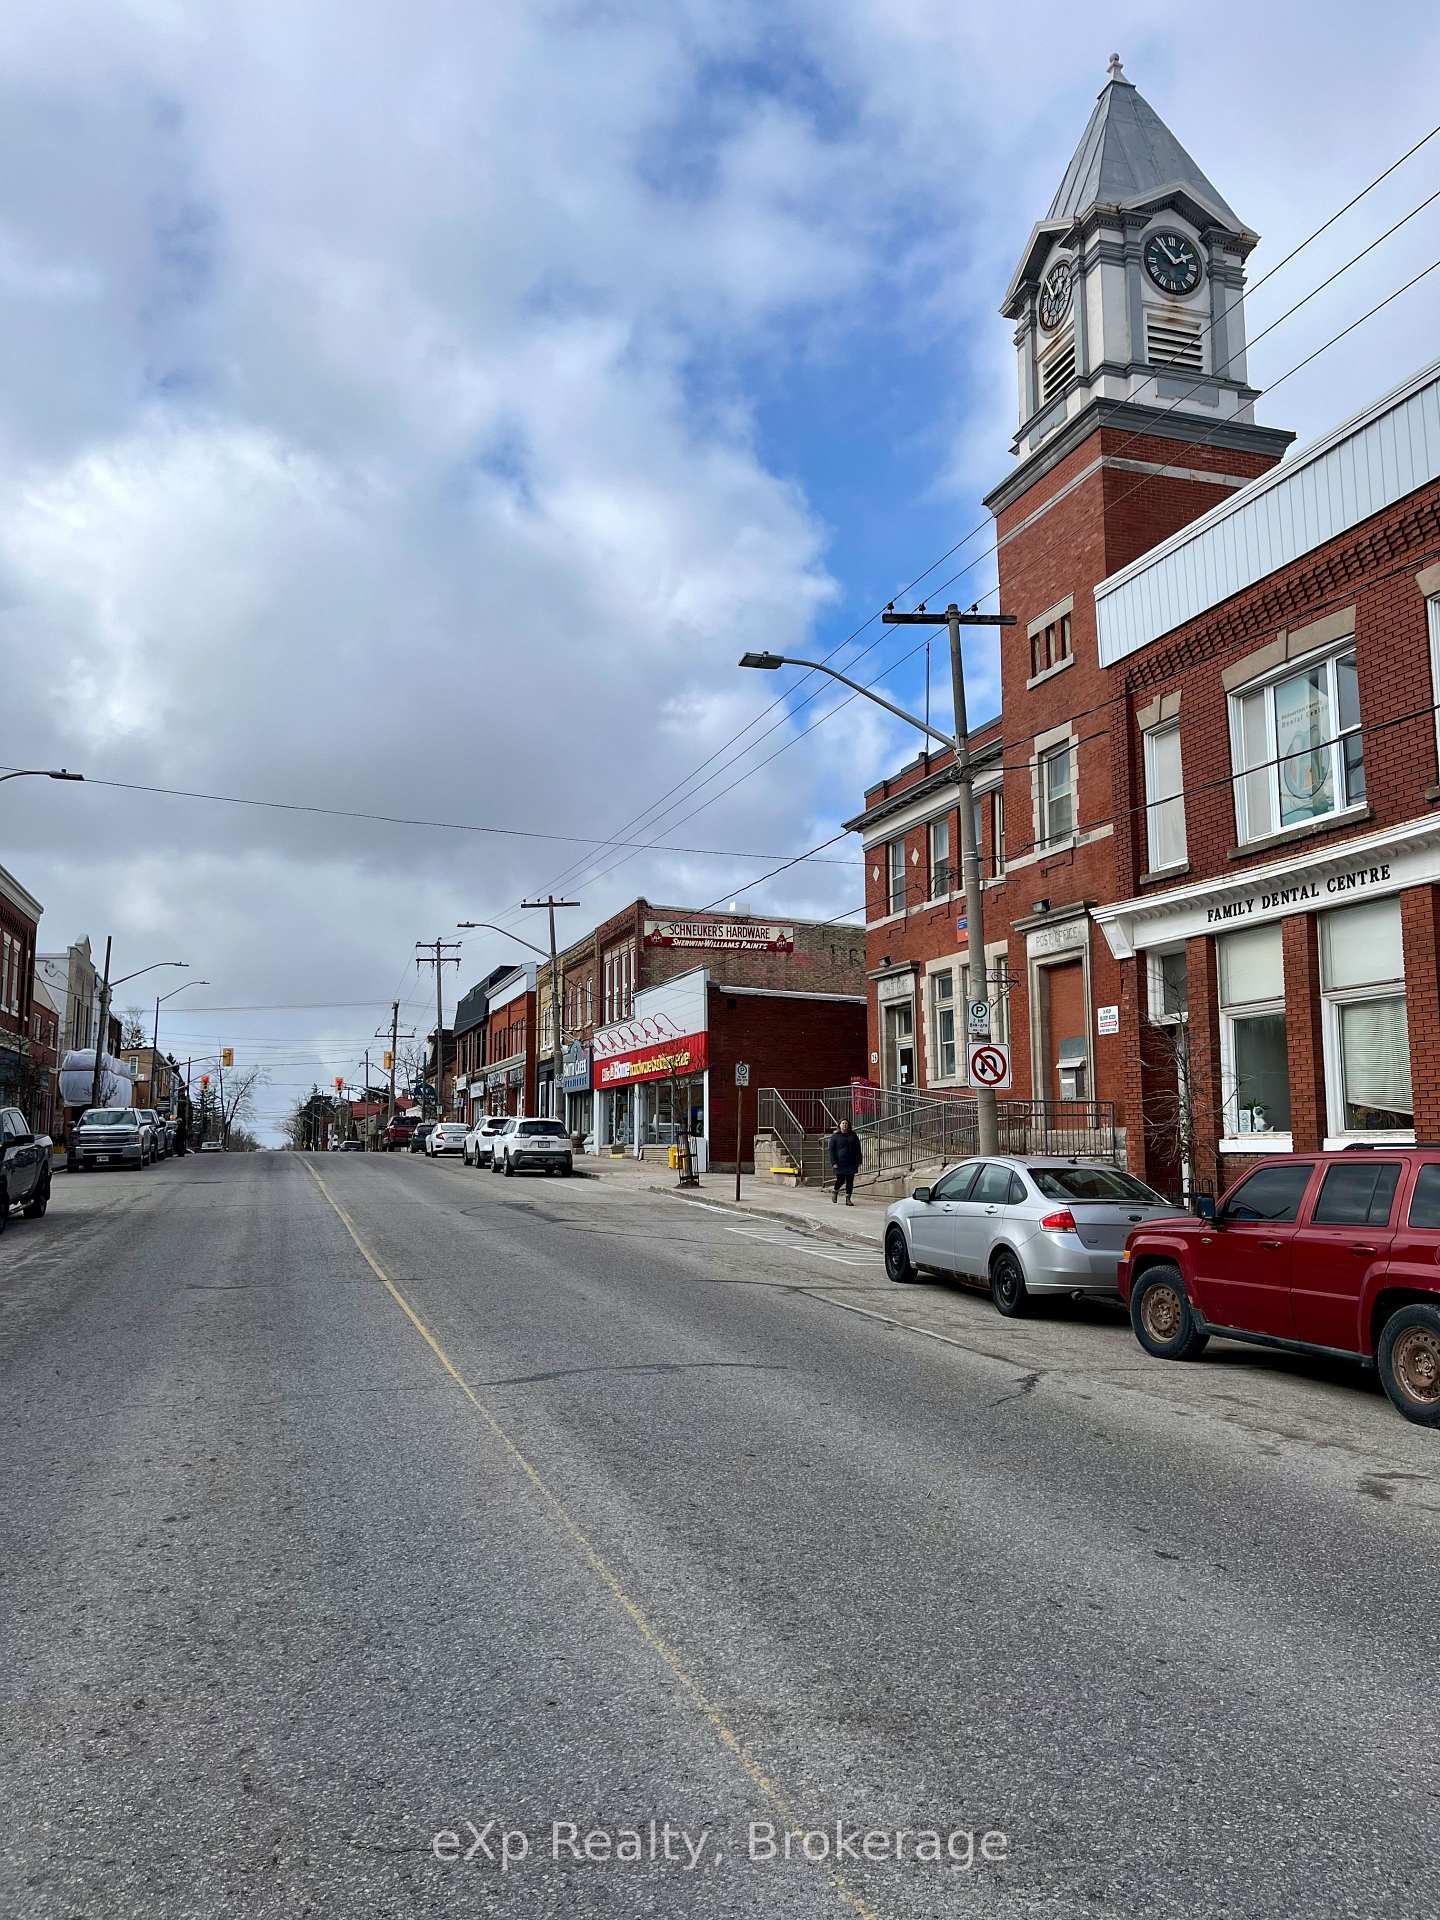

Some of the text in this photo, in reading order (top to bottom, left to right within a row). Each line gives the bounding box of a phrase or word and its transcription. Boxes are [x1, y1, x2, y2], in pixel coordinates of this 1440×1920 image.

[1207, 864, 1391, 923] FAMILY DENTAL CENTRE
[669, 923, 771, 940] SCHNEUKER'S HARDWARE
[740, 941, 768, 950] PAINTS
[1035, 933, 1052, 947] POST
